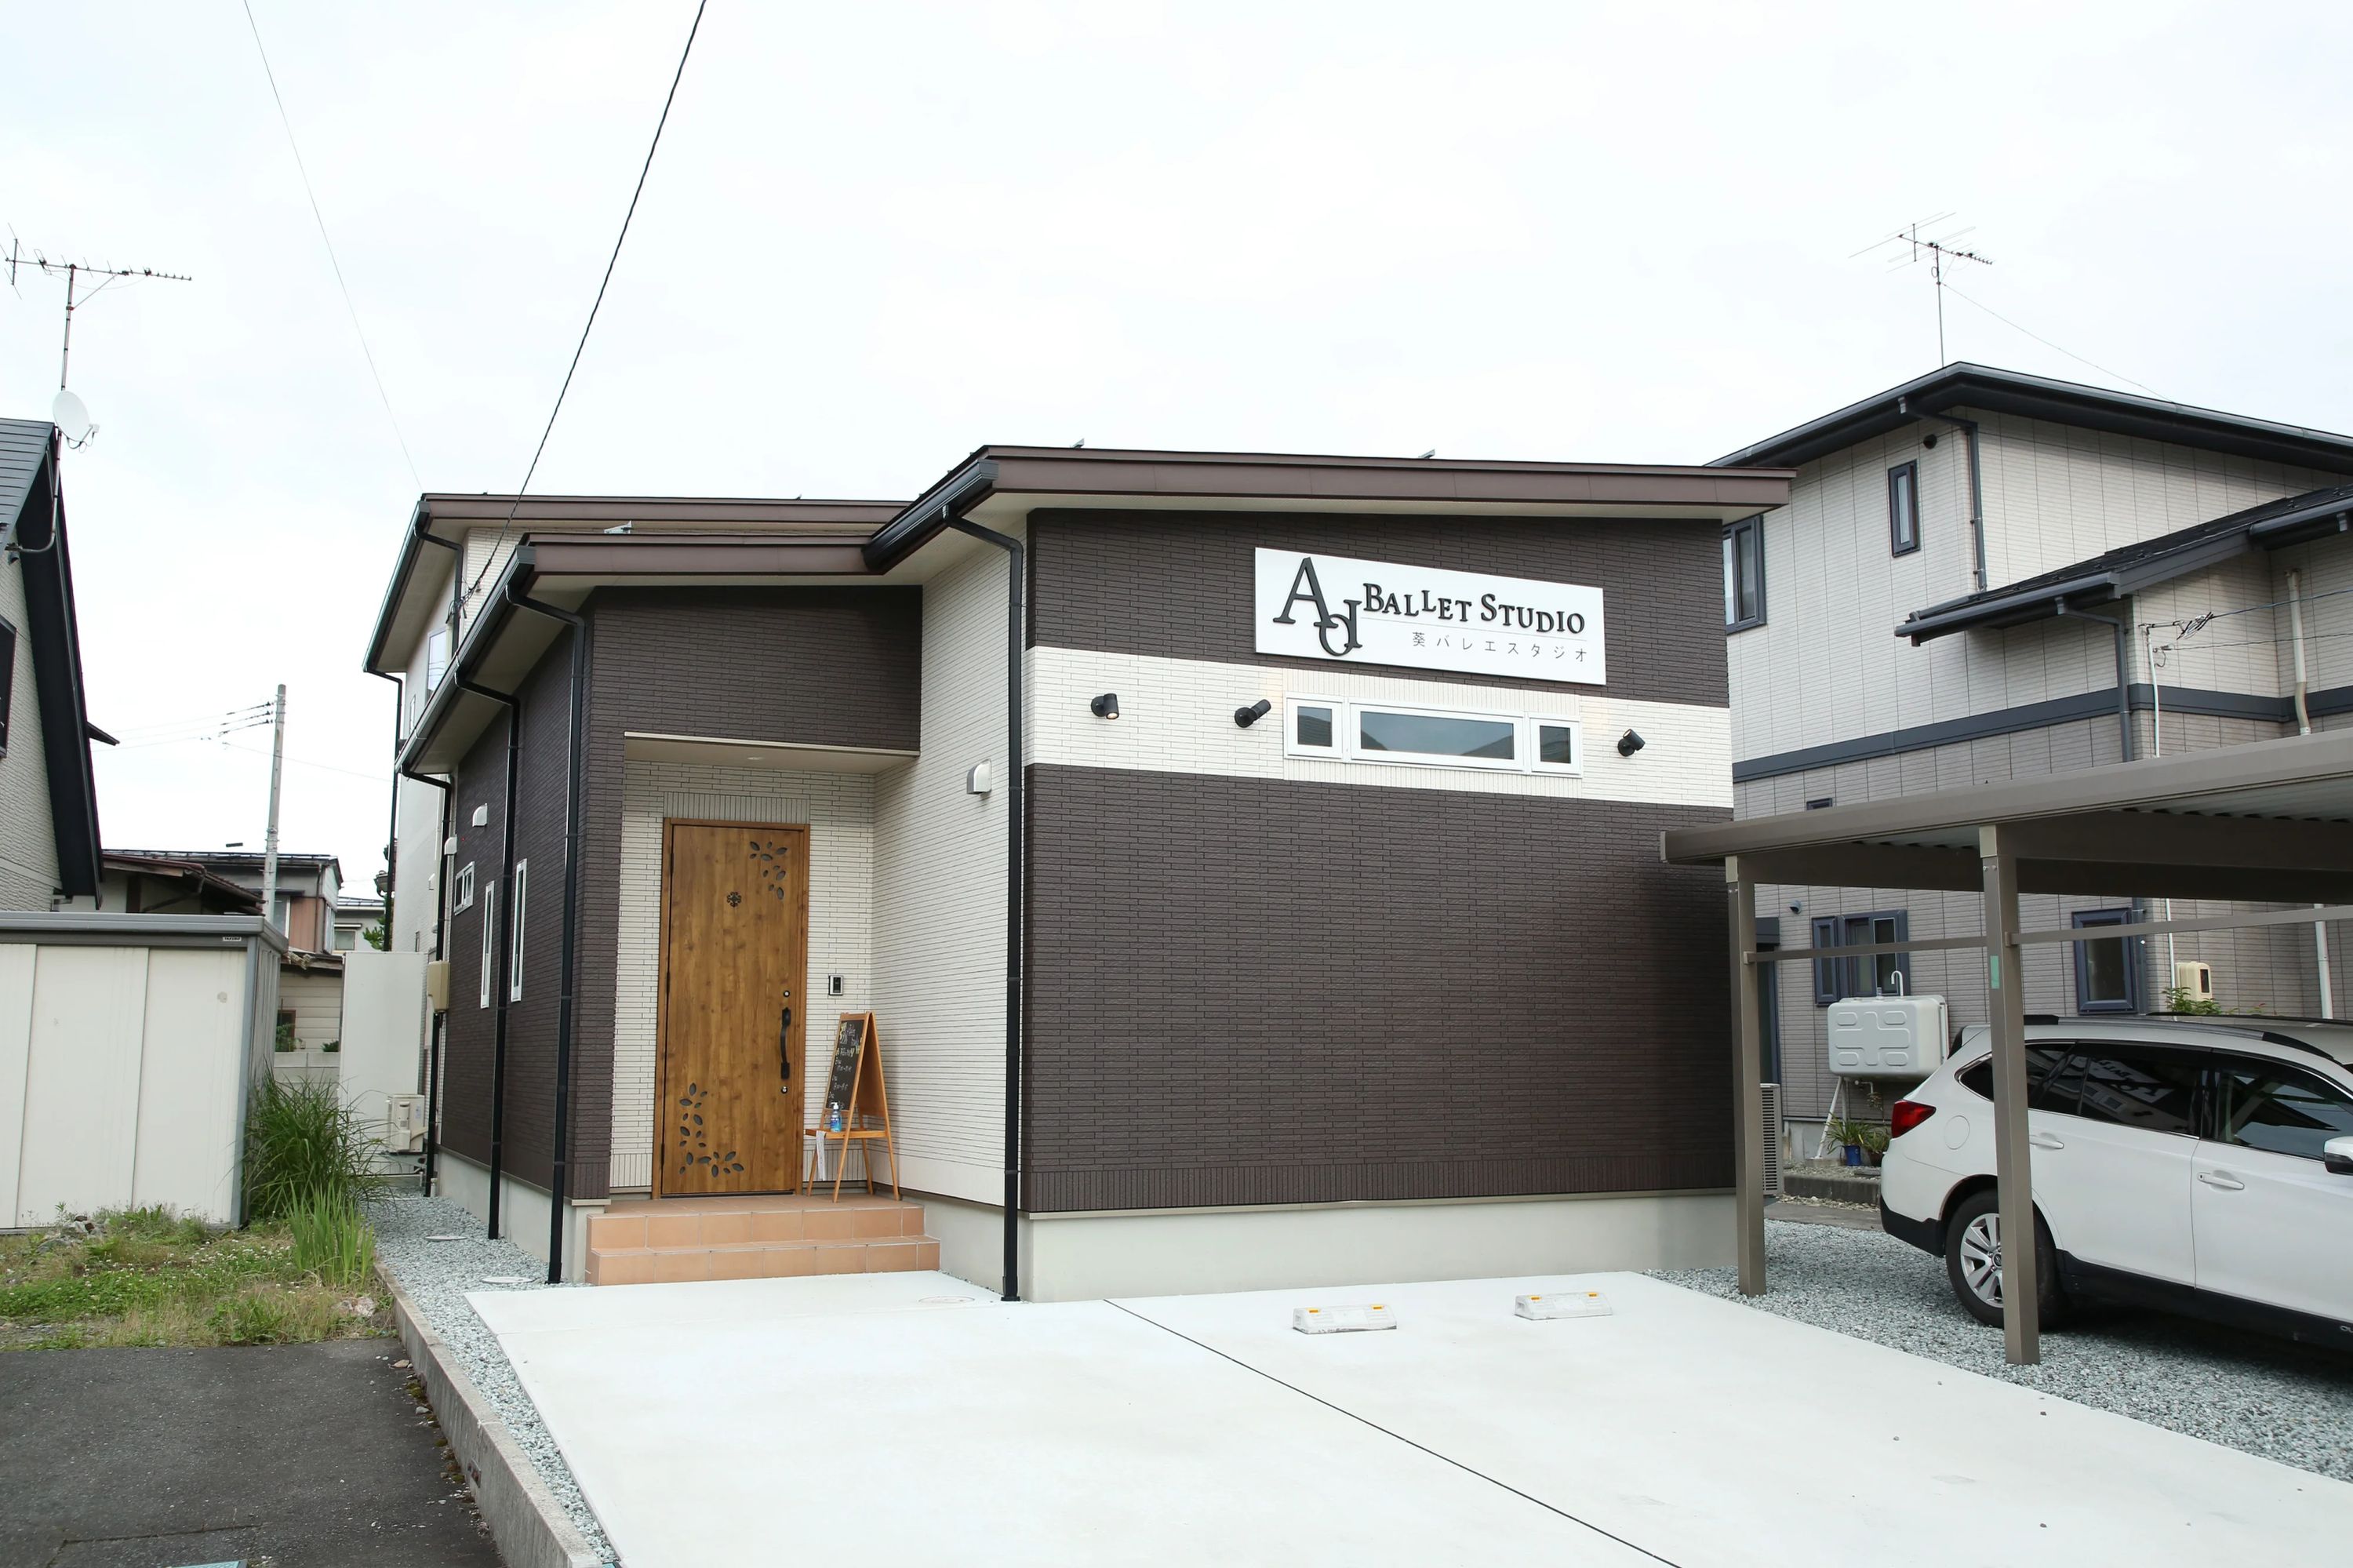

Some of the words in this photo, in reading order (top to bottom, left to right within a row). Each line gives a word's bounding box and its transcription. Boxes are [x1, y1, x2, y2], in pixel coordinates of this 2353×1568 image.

[1362, 583, 1472, 622] BALLET
[1480, 593, 1585, 634] STUDIO
[1413, 631, 1587, 662] 葵バレエスタジオ
